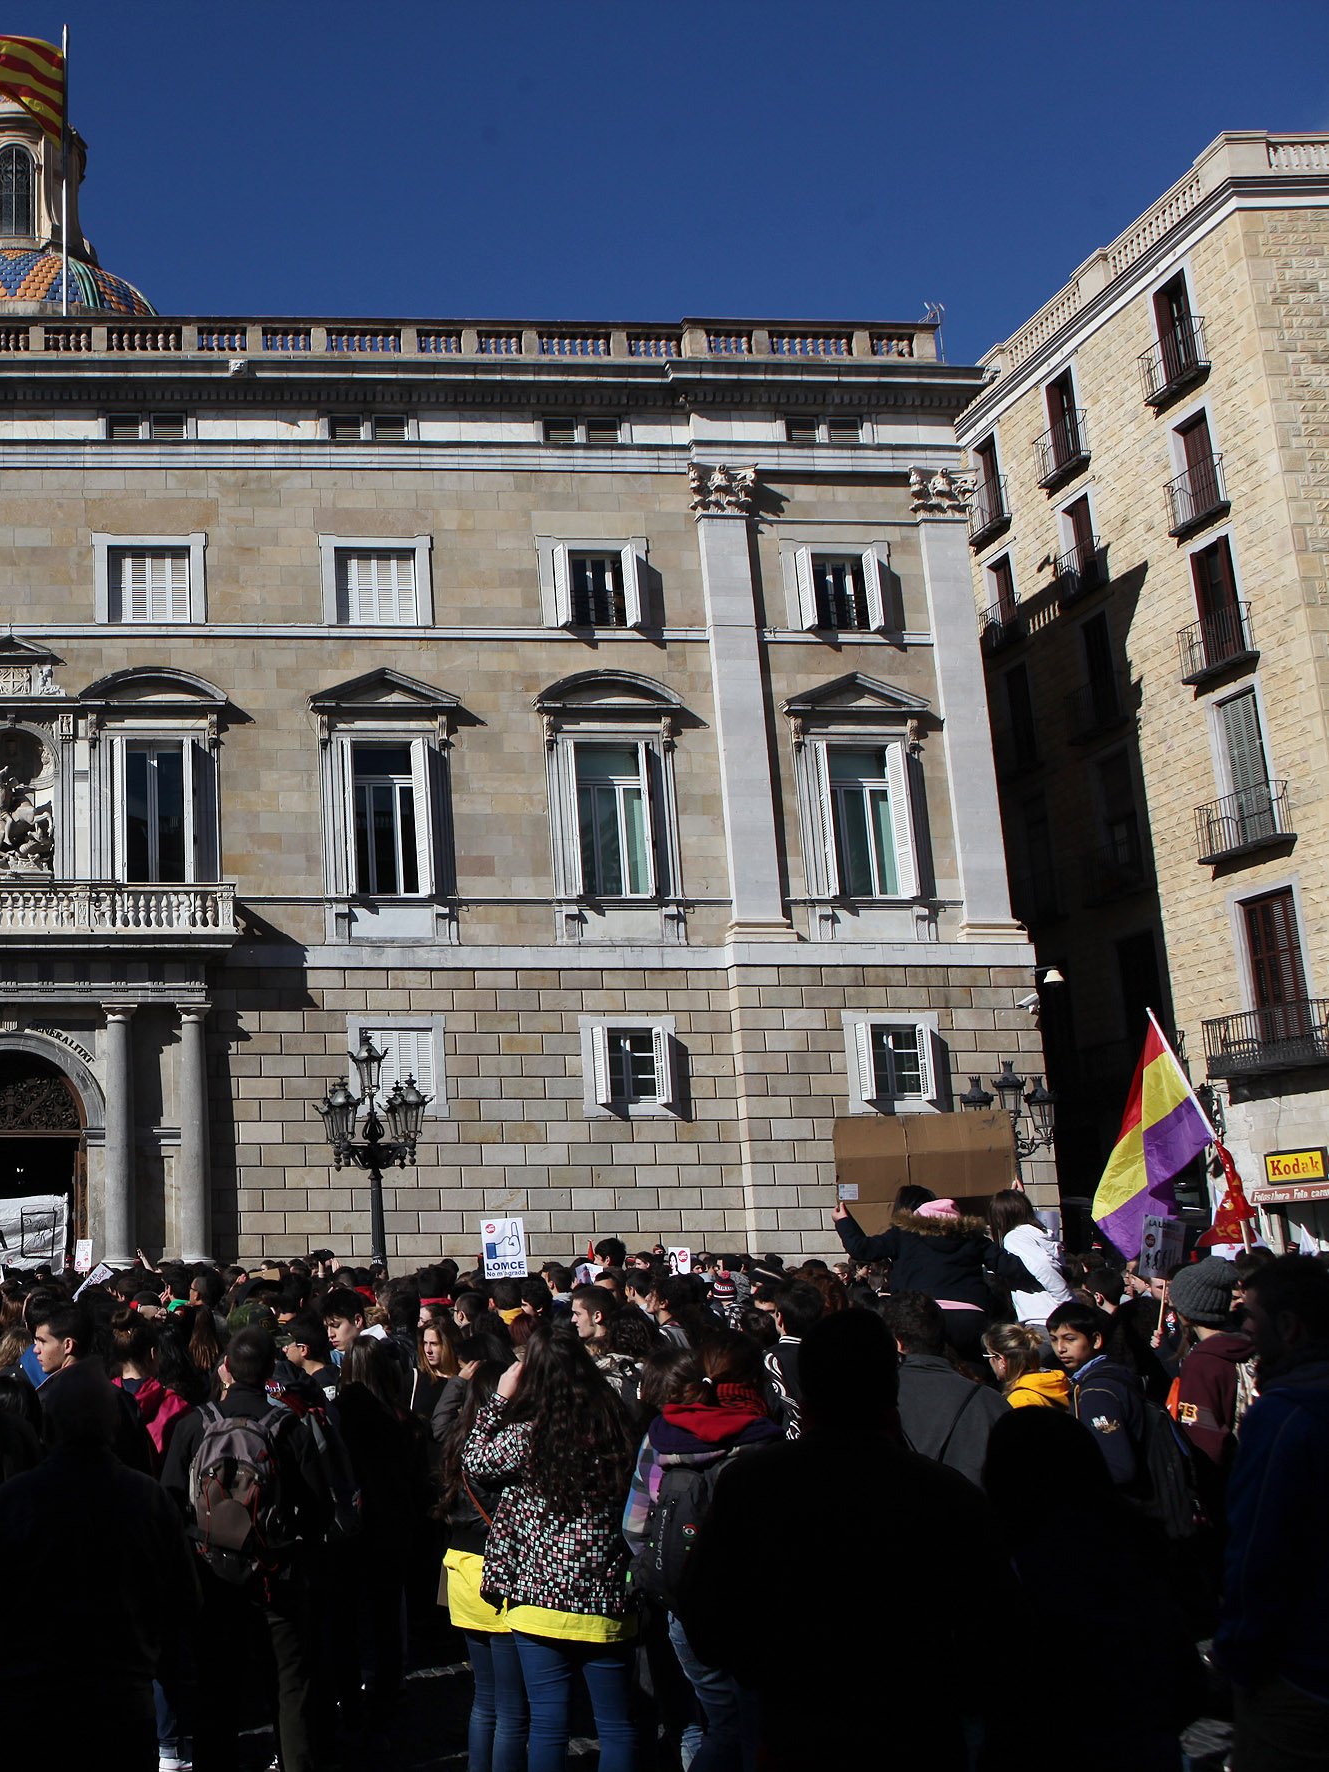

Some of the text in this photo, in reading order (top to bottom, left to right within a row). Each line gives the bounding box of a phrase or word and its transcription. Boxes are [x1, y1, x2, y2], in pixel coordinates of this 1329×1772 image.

[28, 1023, 95, 1063] GENERALITAT
[1270, 1156, 1320, 1176] Kodak
[1293, 1188, 1309, 1199] Foto
[486, 1261, 525, 1271] LOMCE
[655, 1509, 668, 1570] Quechua
